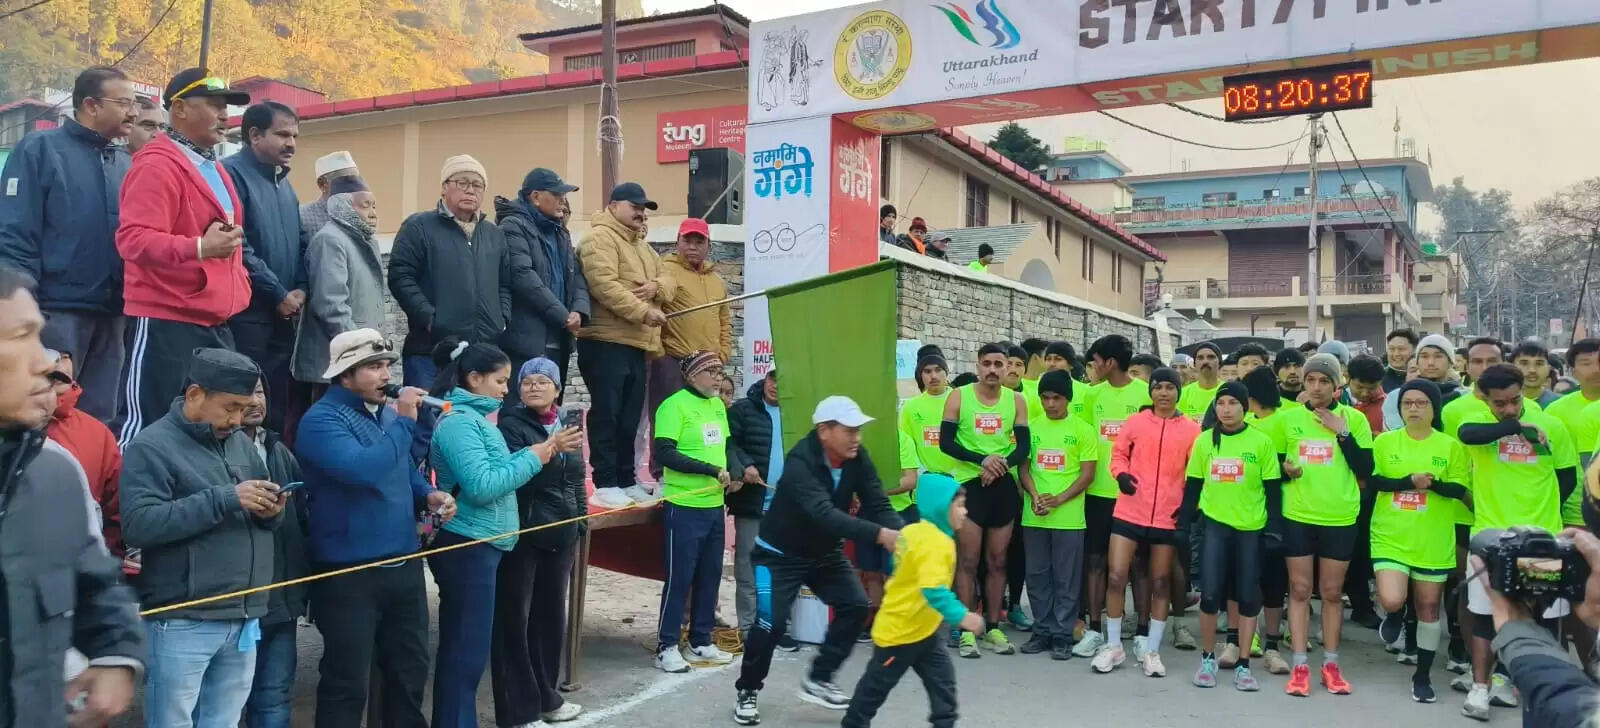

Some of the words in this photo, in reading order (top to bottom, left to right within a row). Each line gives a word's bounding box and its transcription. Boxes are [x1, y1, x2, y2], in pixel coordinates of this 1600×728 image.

[943, 48, 1039, 73] Uttarakhand
[945, 75, 979, 92] Simply
[1225, 71, 1371, 113] 08:20:37
[665, 143, 692, 151] Museum
[719, 135, 741, 145] Centre
[753, 142, 798, 167] नमामि
